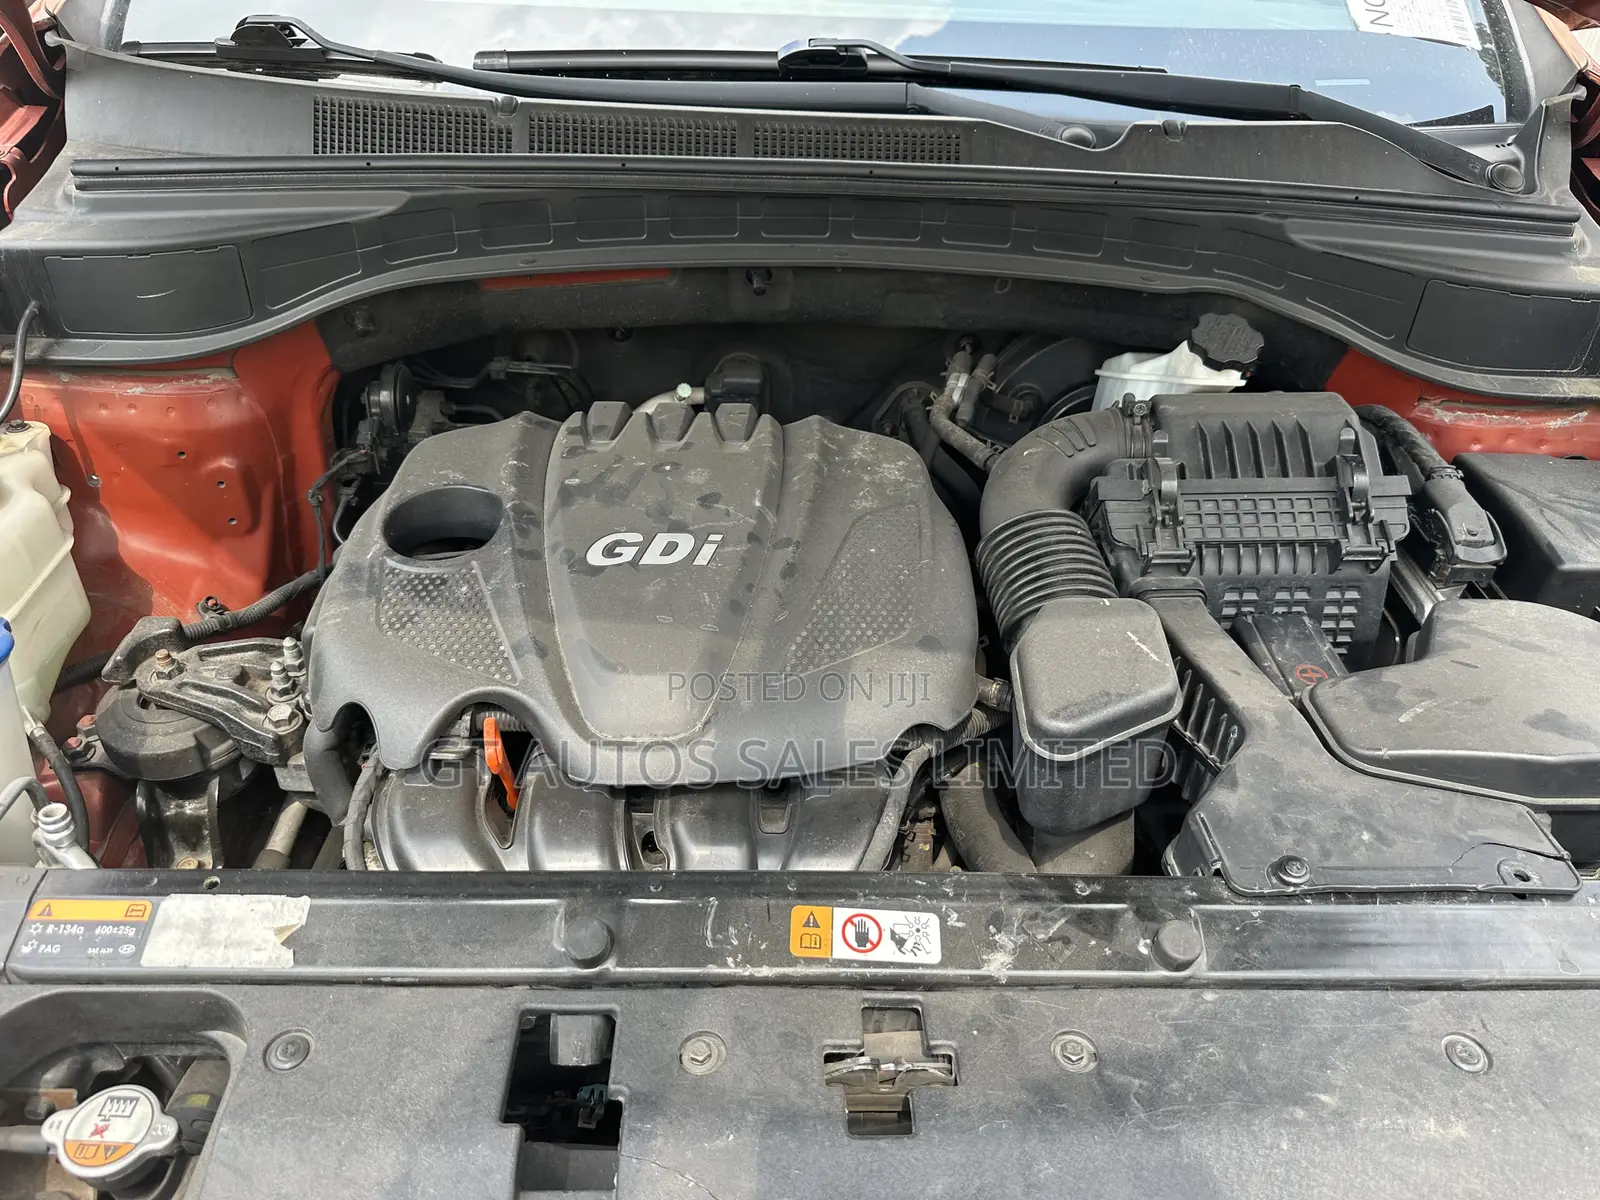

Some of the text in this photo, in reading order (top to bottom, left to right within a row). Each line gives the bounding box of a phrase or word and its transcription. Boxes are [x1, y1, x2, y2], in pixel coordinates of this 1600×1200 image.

[585, 532, 724, 566] GDi
[46, 924, 136, 936] R-134a 600±25g
[38, 944, 61, 954] PAG
